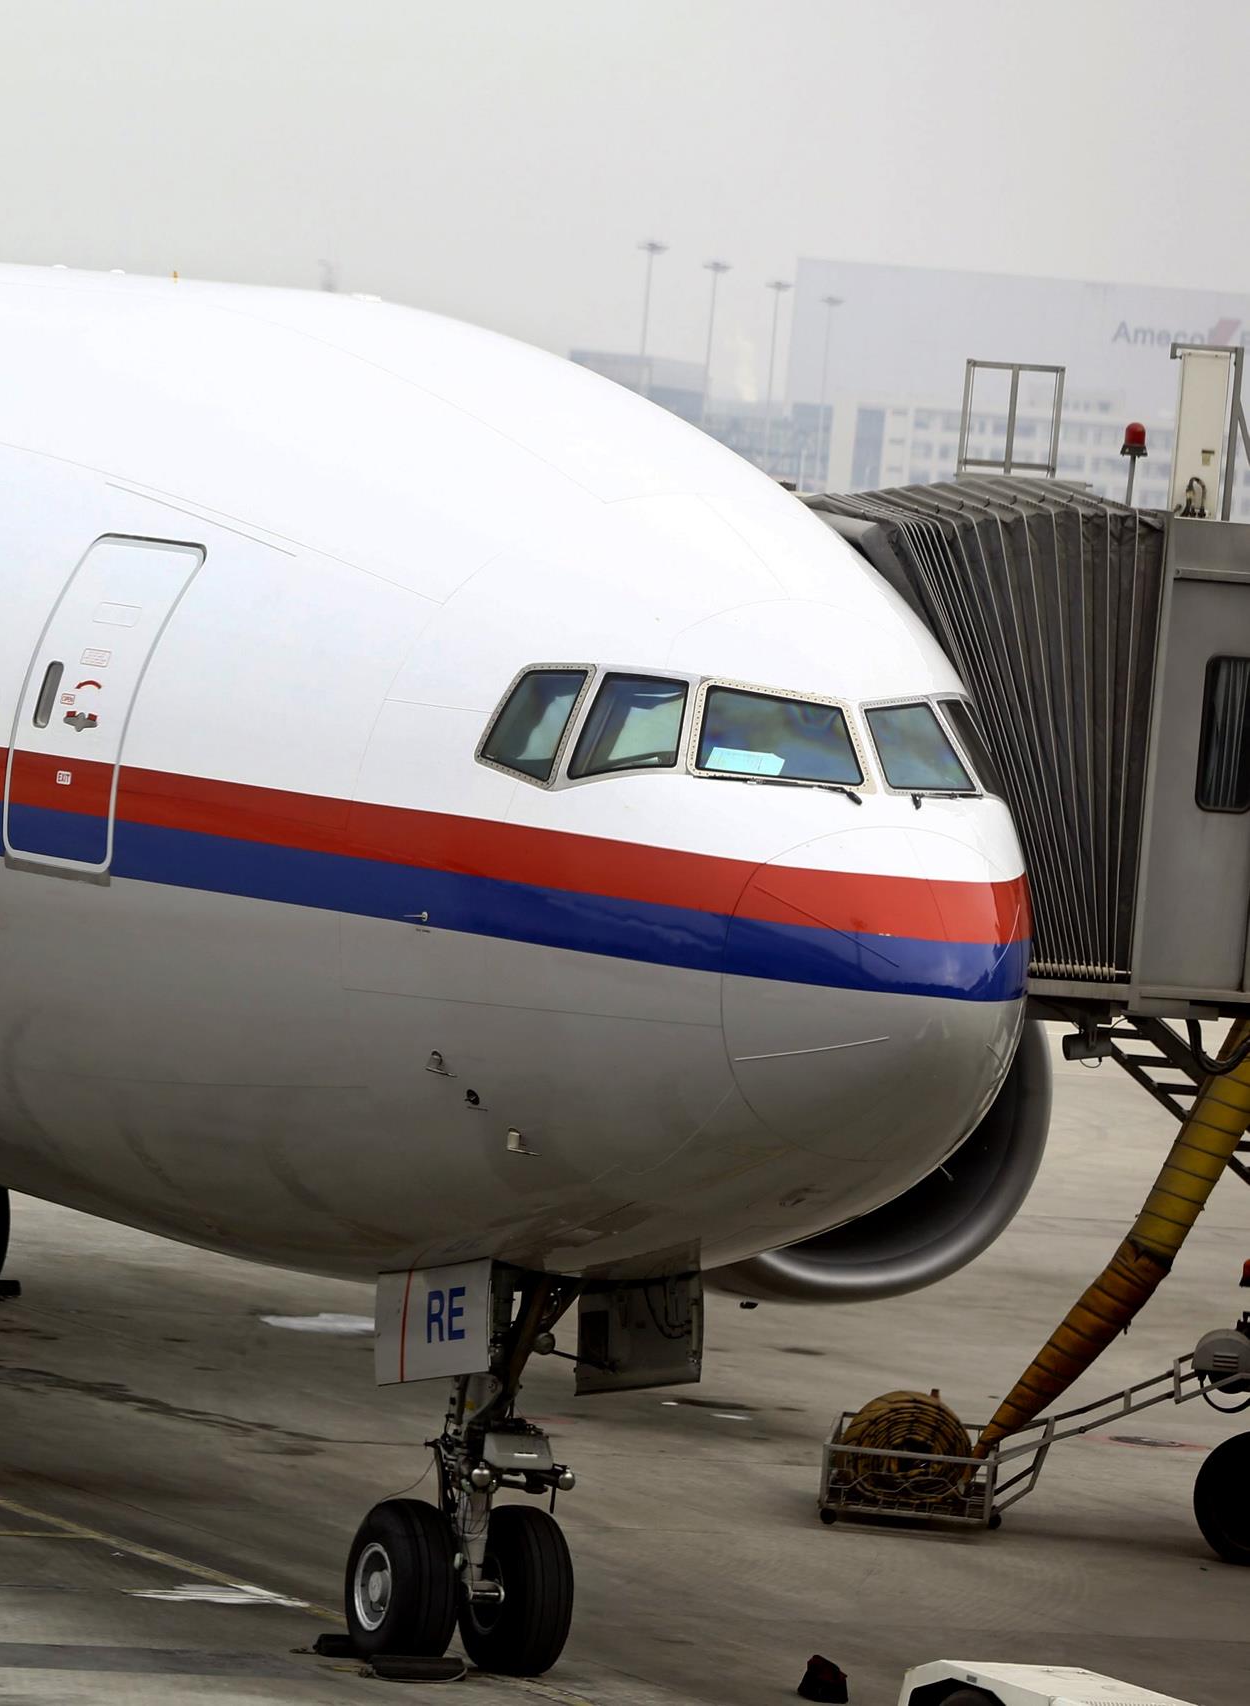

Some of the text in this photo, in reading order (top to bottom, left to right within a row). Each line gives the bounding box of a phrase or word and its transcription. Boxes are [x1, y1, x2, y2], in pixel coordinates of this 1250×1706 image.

[1112, 319, 1205, 347] Ameco
[58, 772, 70, 783] EXIT
[426, 1286, 466, 1343] RE
